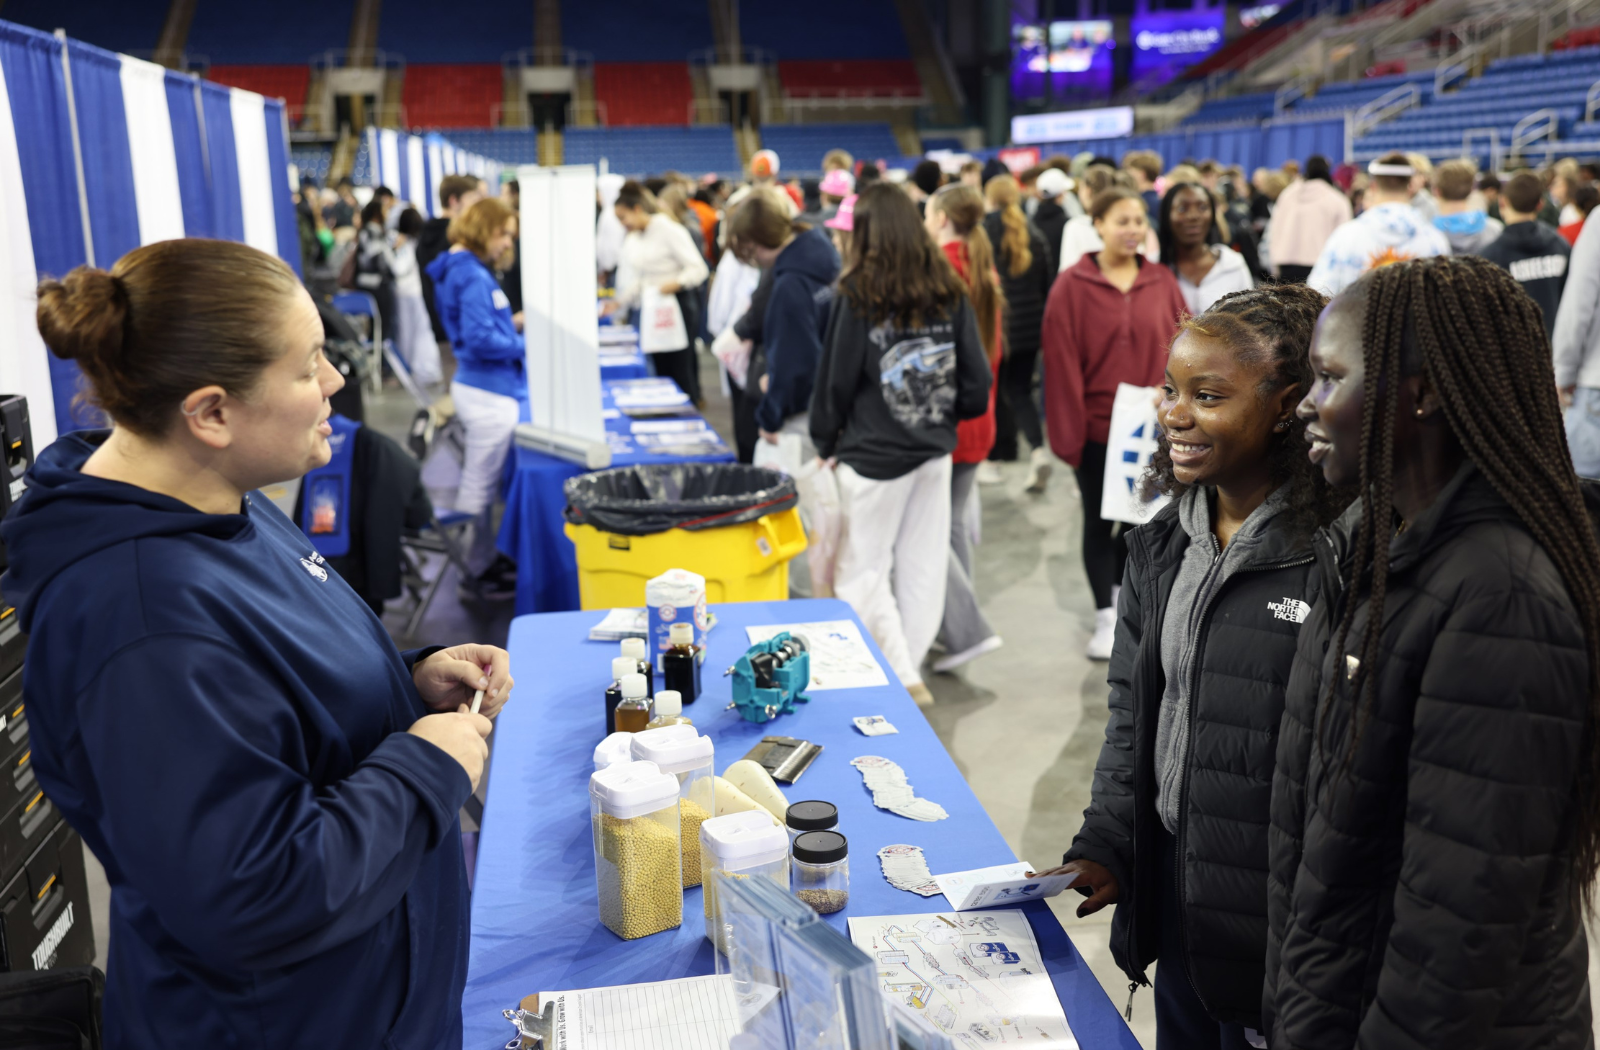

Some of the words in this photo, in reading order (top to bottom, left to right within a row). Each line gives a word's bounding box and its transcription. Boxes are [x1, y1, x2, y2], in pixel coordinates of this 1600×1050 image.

[1282, 597, 1300, 607] THE
[1267, 602, 1297, 614] NORTH
[1274, 611, 1296, 622] FACE
